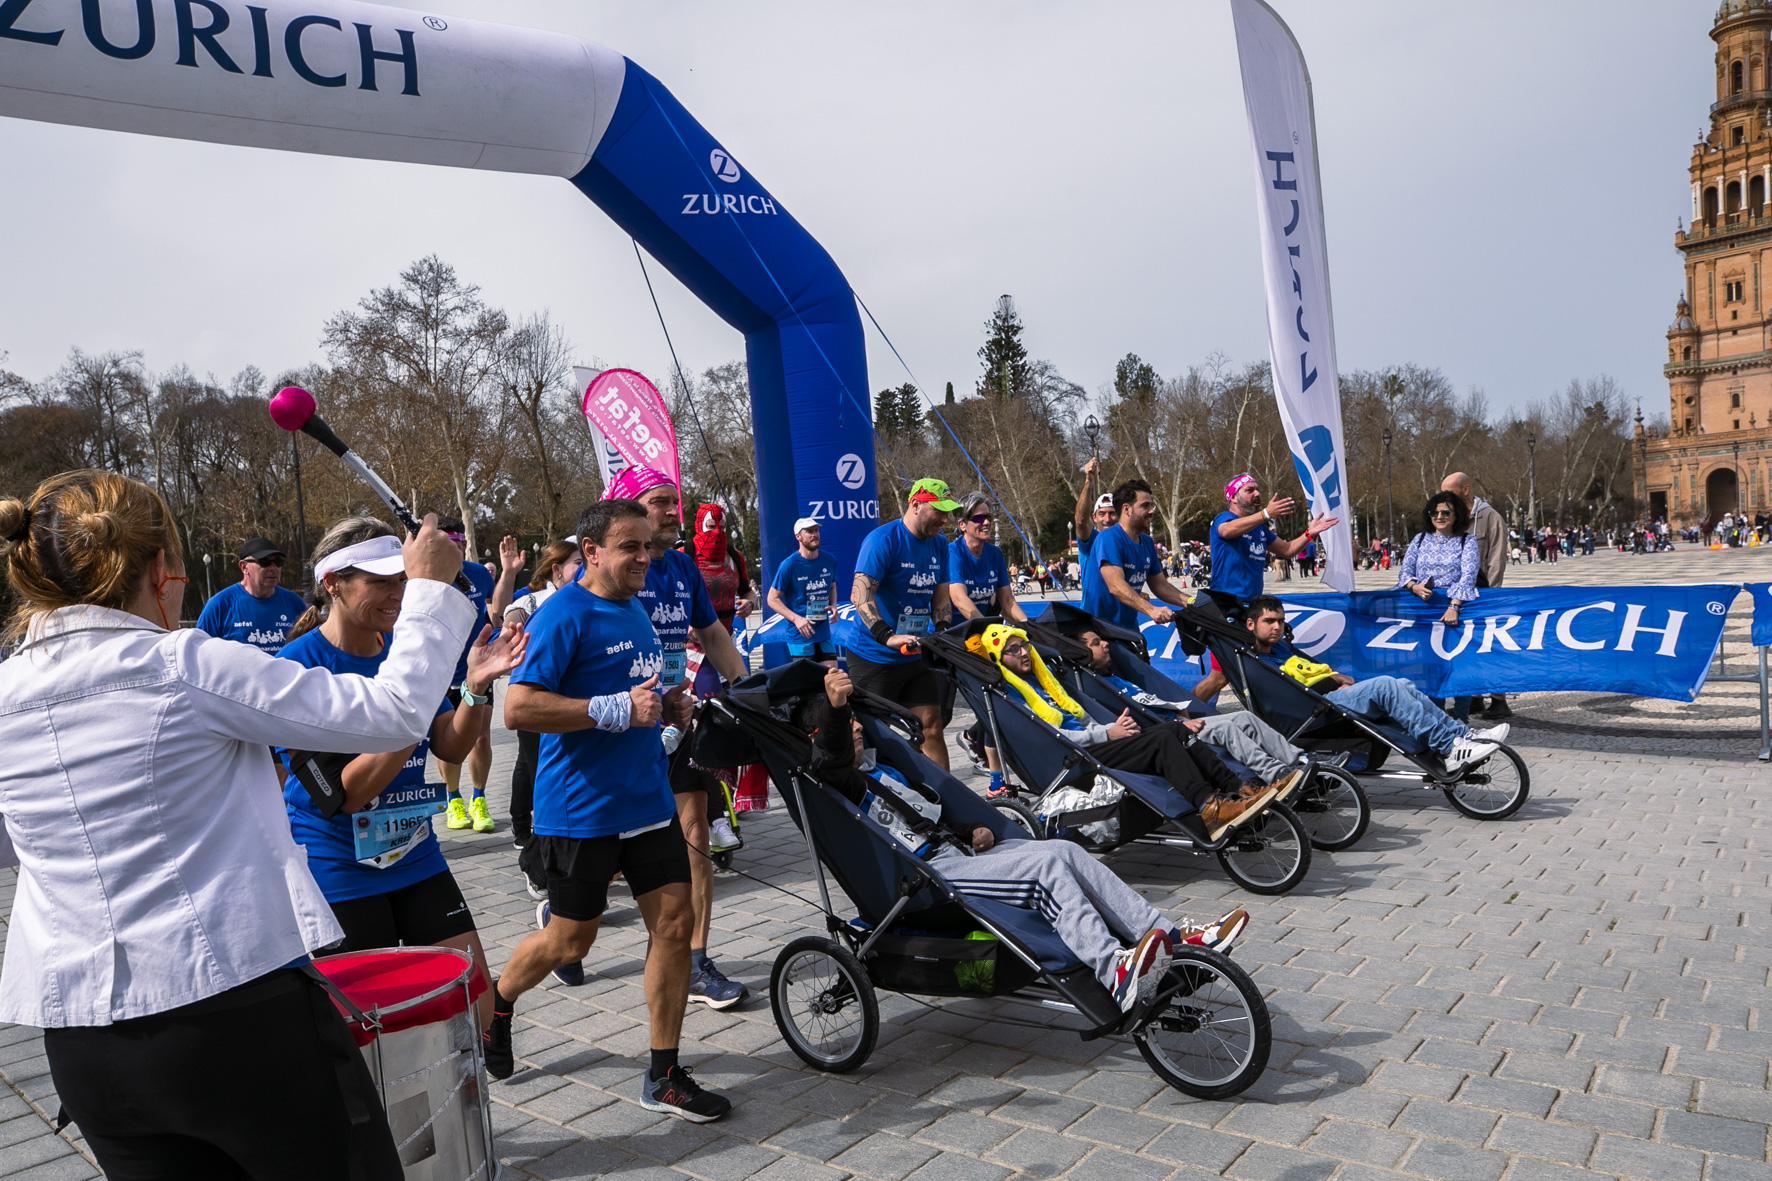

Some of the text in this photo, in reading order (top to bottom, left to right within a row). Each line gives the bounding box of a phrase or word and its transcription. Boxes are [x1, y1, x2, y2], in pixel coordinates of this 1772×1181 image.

[681, 193, 777, 215] ZURICH
[808, 500, 880, 520] ZURICH
[1365, 600, 1689, 661] ZURICH
[606, 639, 634, 655] aefat
[386, 788, 436, 804] ZURICH
